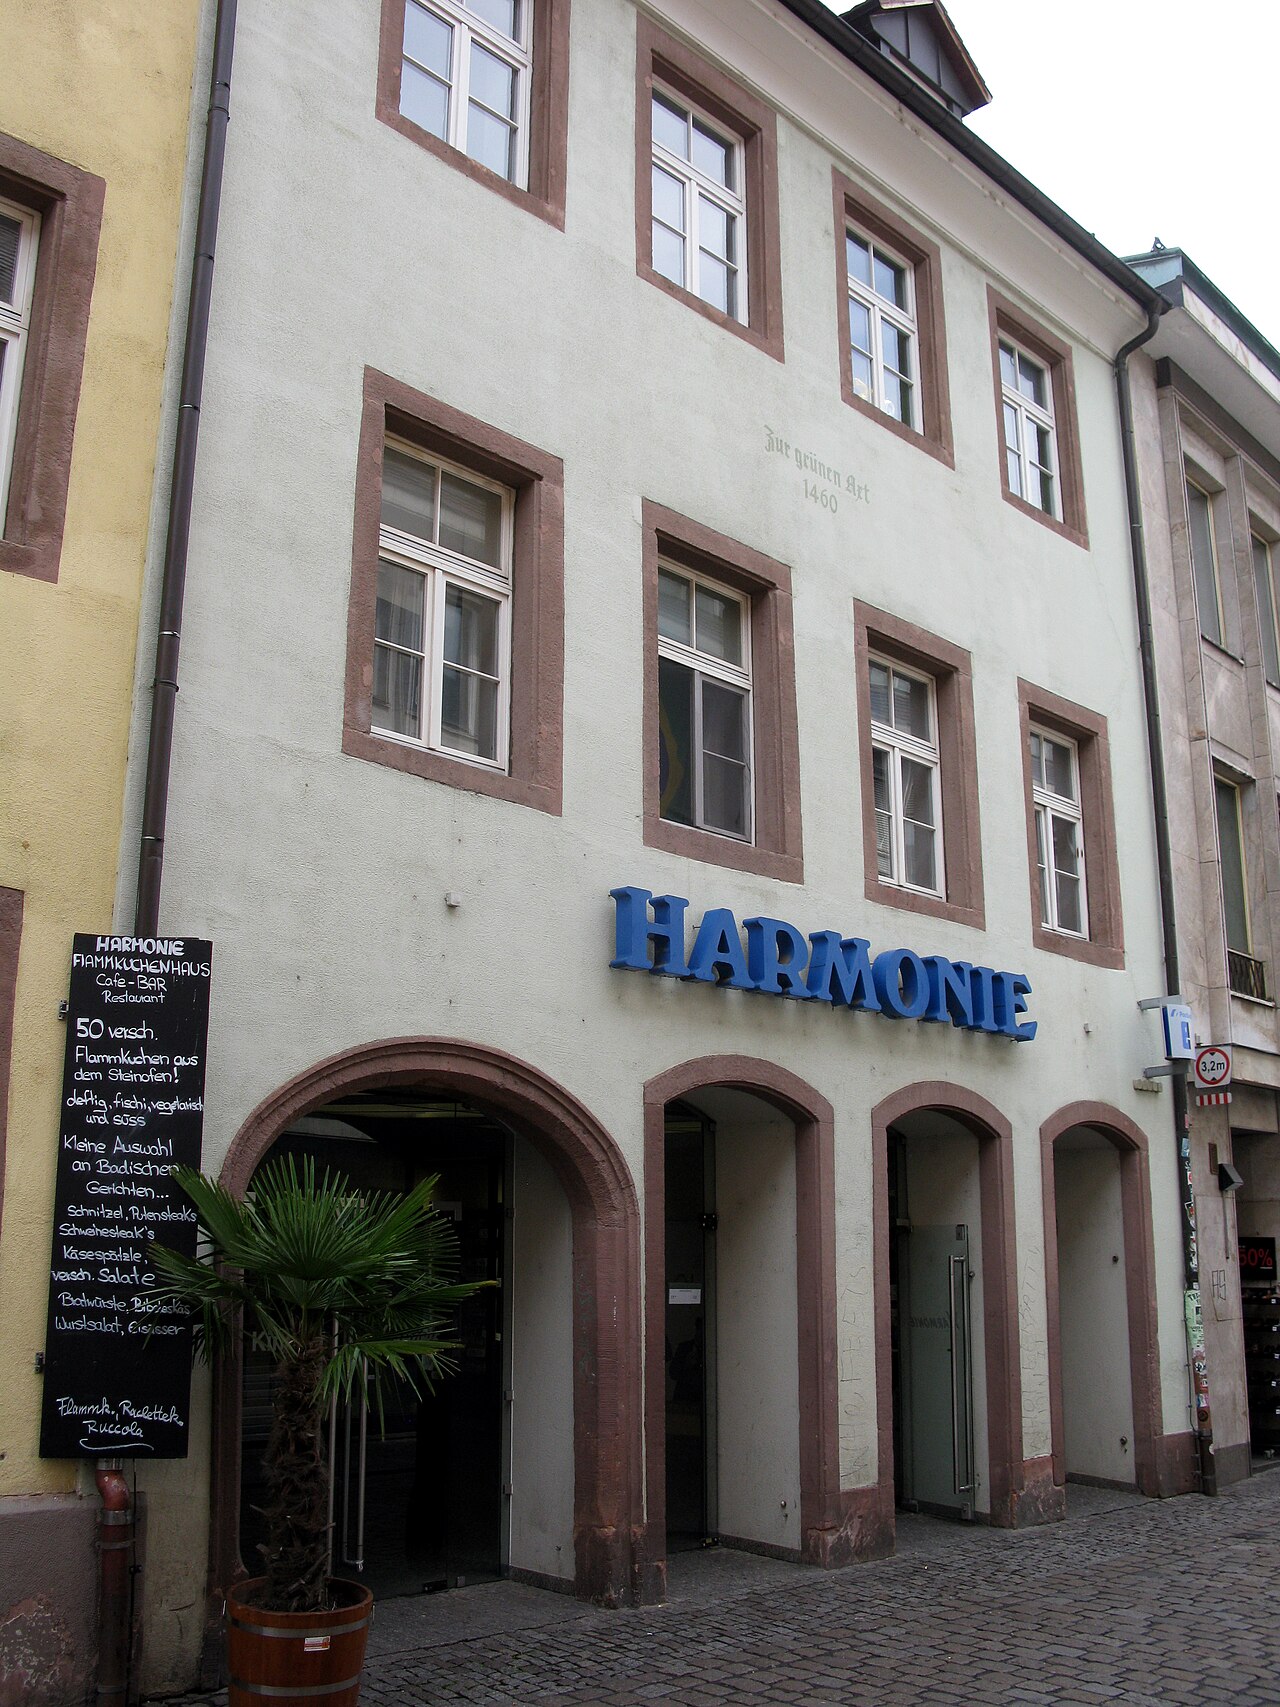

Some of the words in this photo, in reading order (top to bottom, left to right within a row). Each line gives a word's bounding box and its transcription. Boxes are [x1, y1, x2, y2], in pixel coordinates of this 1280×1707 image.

[764, 424, 791, 459] Zur
[794, 447, 841, 488] grünen
[802, 478, 838, 514] 1460
[96, 936, 185, 957] HARMONIE
[609, 885, 1038, 1042] HARMONIE
[101, 990, 165, 1004] Restaurant
[76, 1018, 104, 1039] 50
[108, 1020, 158, 1041] versch.
[173, 1055, 199, 1066] aus
[74, 1068, 102, 1081] dem
[108, 1068, 179, 1084] Steinofen!
[66, 1088, 112, 1112] deftig,
[86, 1111, 109, 1125] und
[113, 1113, 146, 1126] süss
[63, 1134, 106, 1153] Kleine
[113, 1135, 173, 1156] Auswahl
[72, 1159, 91, 1172] an
[95, 1158, 179, 1176] Badischen
[67, 1203, 129, 1221] Schnitzel,
[51, 1268, 95, 1281] versch.
[97, 1266, 156, 1286] Salate
[55, 1315, 125, 1336] Wurstsalat,
[82, 1420, 144, 1437] Ruccola
